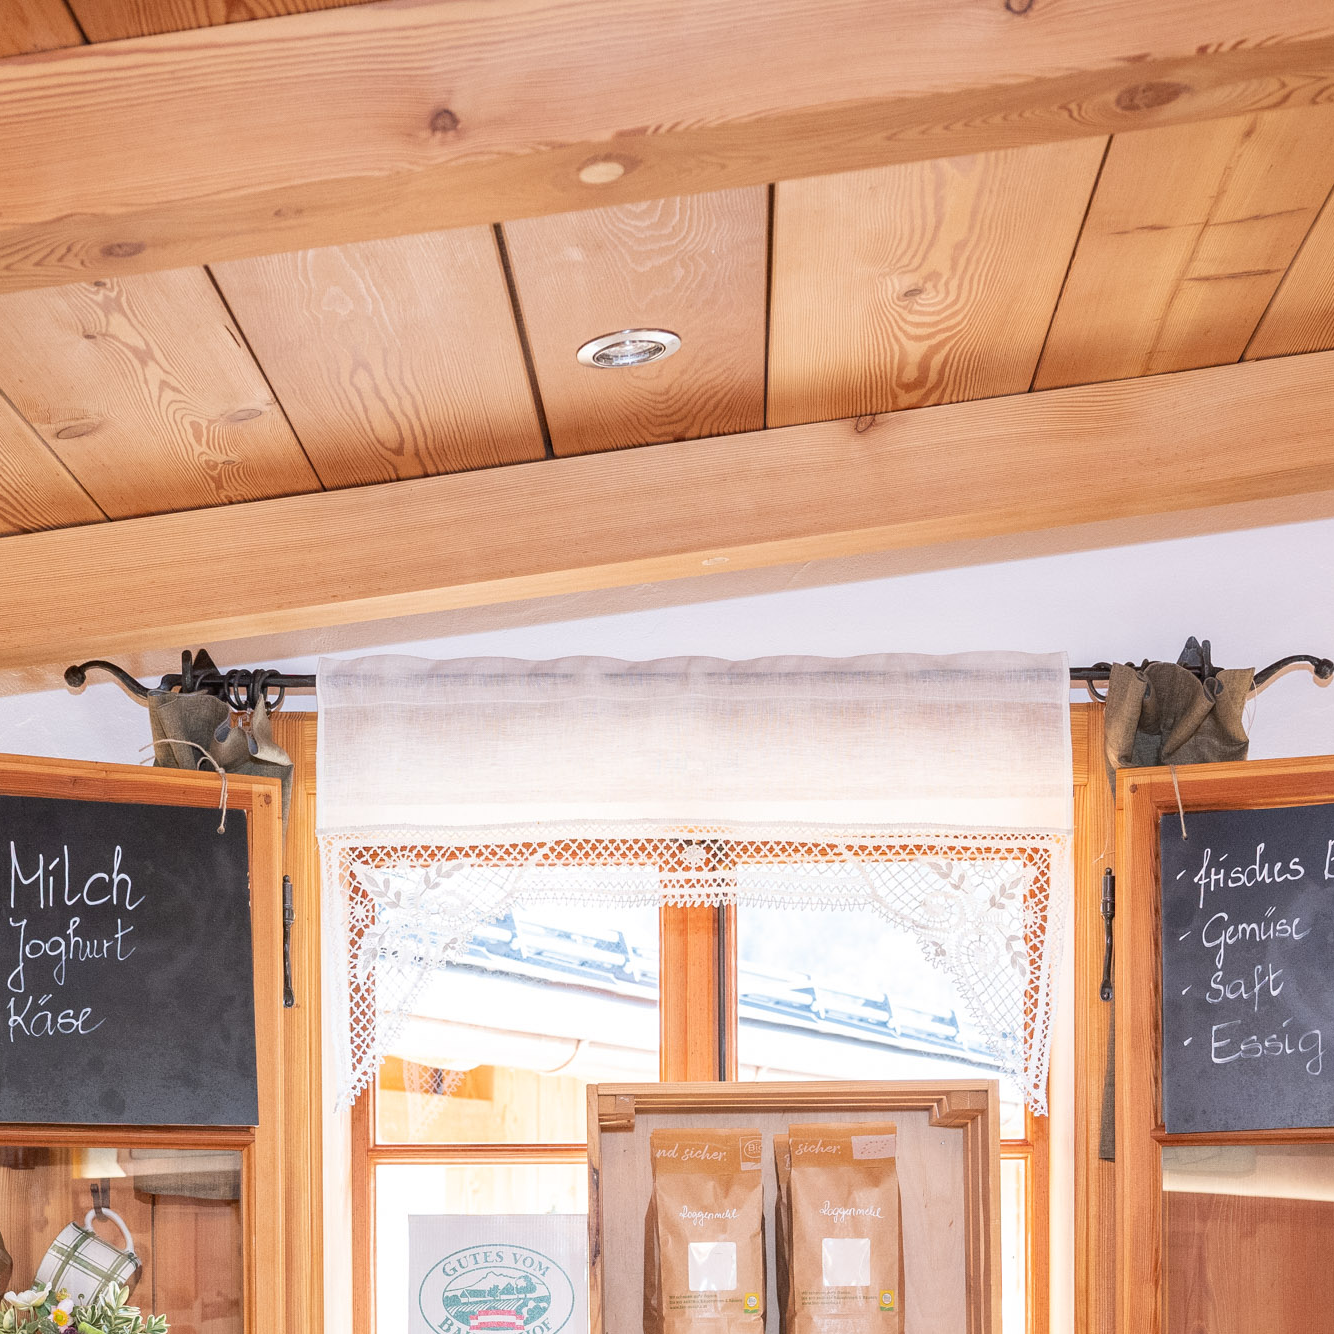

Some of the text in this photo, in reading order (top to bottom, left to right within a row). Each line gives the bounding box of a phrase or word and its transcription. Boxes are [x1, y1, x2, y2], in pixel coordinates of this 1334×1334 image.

[10, 840, 146, 911] Milch
[1193, 842, 1305, 909] frisches
[7, 916, 137, 993] Joghurt
[1202, 906, 1312, 969] Gemüse
[1206, 963, 1285, 1013] Saft
[7, 994, 107, 1043] Käse
[1211, 1017, 1327, 1076] Essig
[655, 1143, 727, 1162] nd sicher.
[794, 1138, 842, 1156] sicher.
[679, 1204, 740, 1227] Roggenmehl
[818, 1199, 885, 1224] Roggenmehl
[441, 1250, 552, 1278] GUTES VOM
